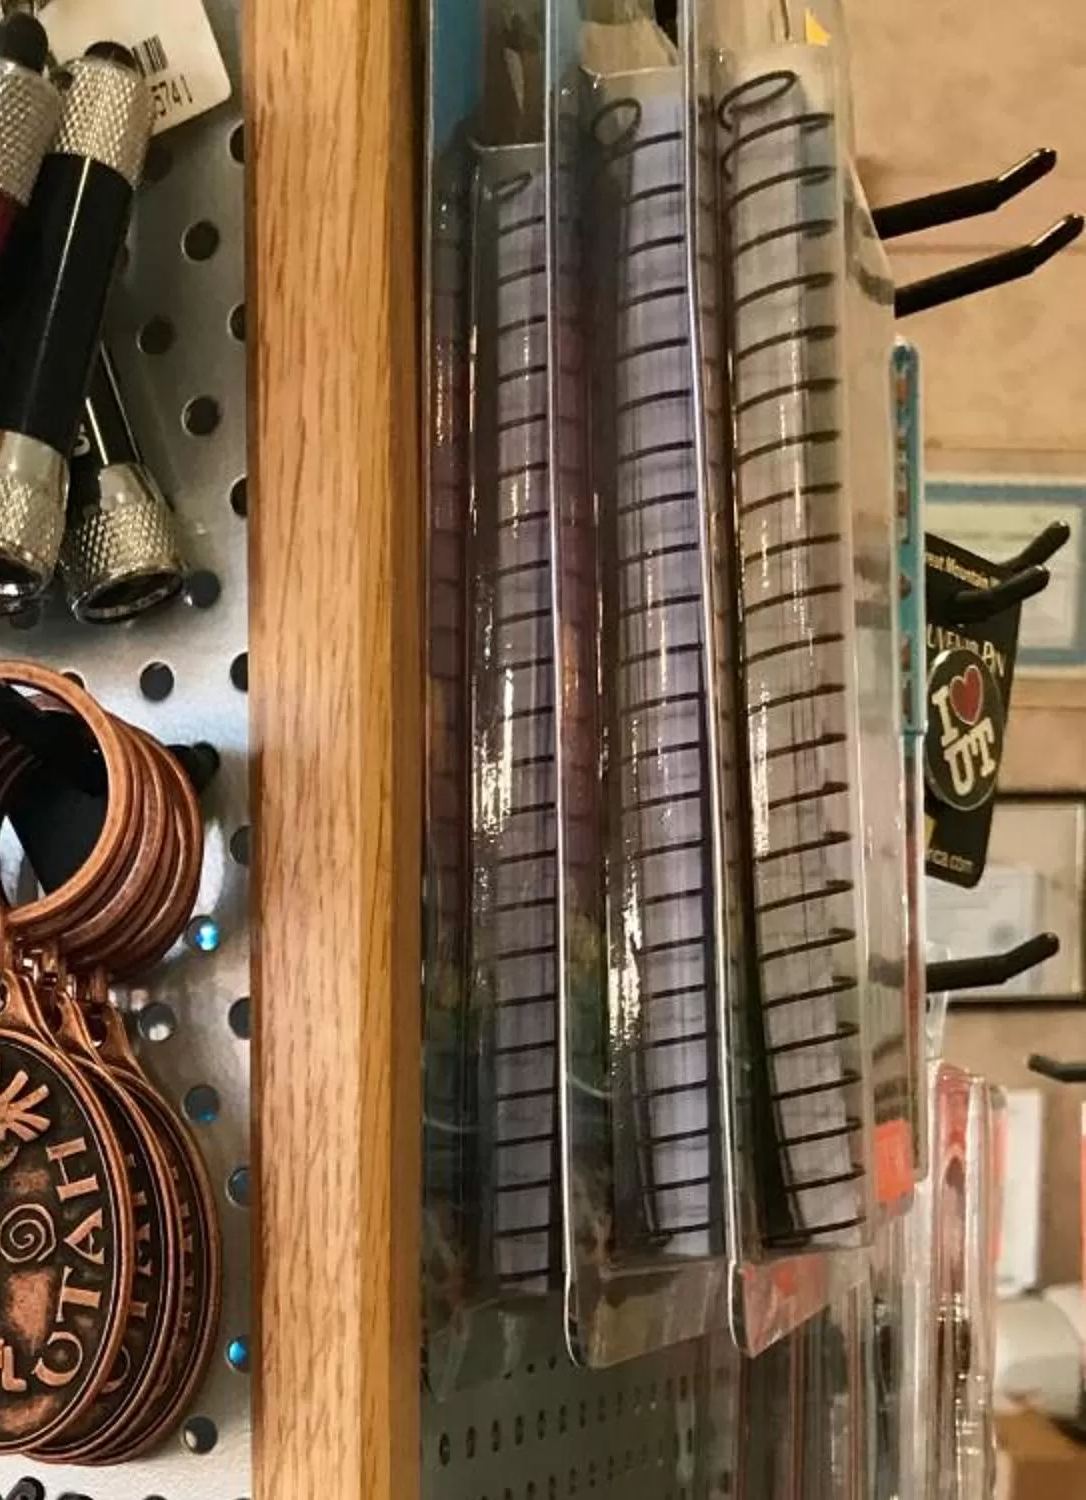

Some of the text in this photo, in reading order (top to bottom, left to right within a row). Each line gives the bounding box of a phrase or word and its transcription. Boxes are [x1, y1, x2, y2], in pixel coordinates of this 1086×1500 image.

[931, 684, 996, 797] I UT
[33, 1138, 106, 1387] UTAH
